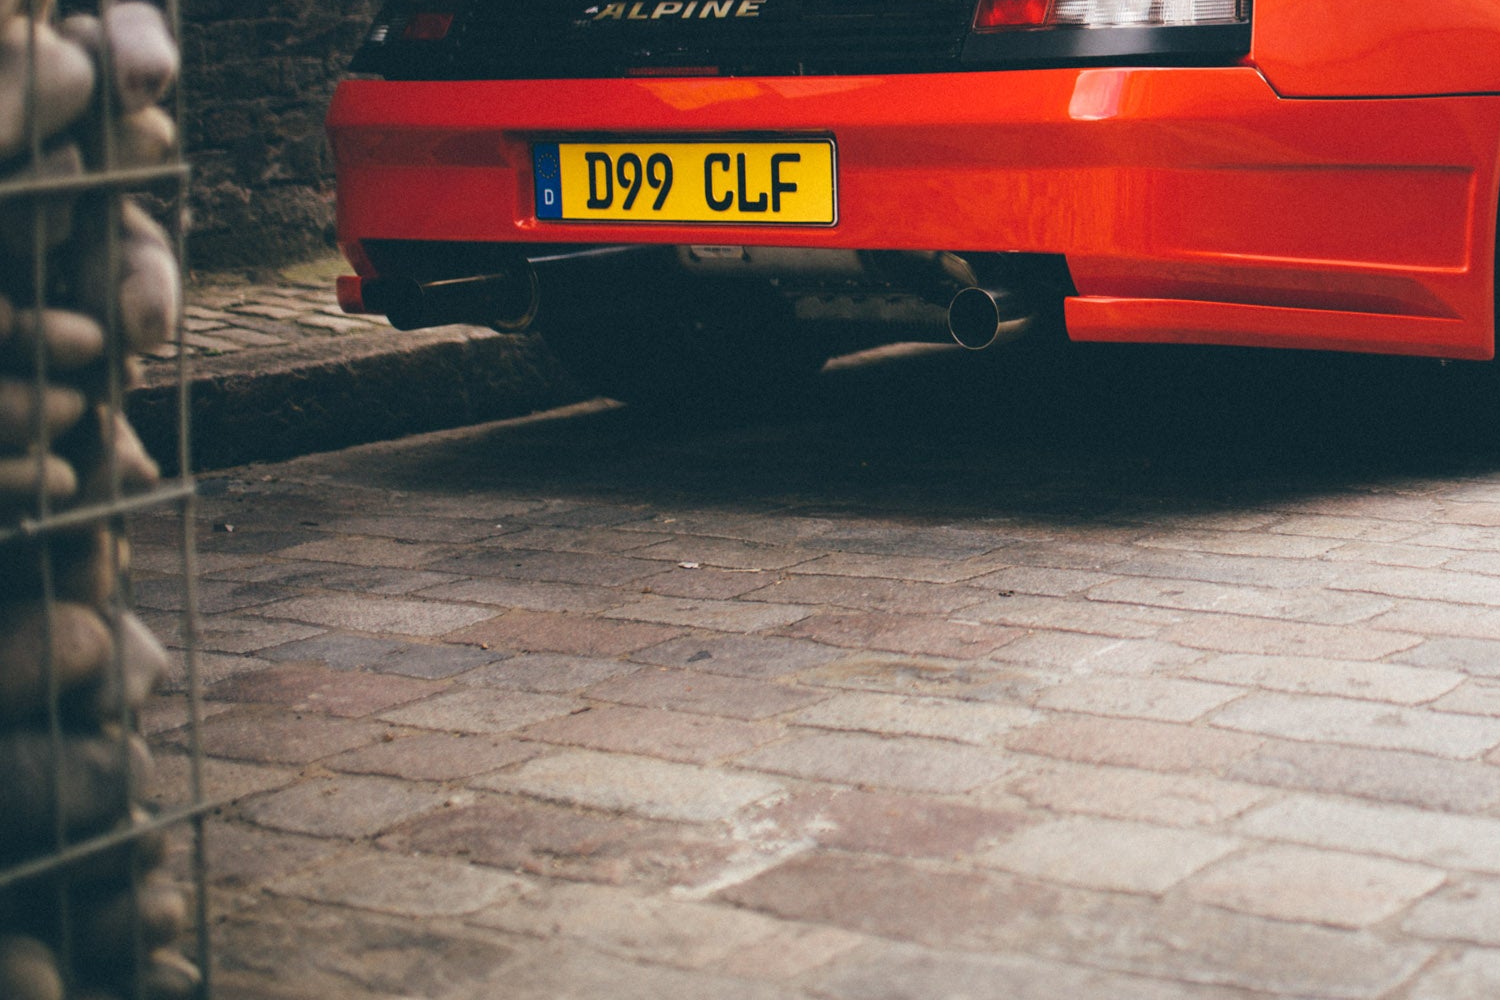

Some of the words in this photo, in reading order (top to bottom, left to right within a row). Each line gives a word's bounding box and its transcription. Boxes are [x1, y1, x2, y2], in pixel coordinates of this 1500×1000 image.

[544, 188, 554, 205] D
[585, 152, 674, 211] D99
[704, 153, 801, 212] CLF
